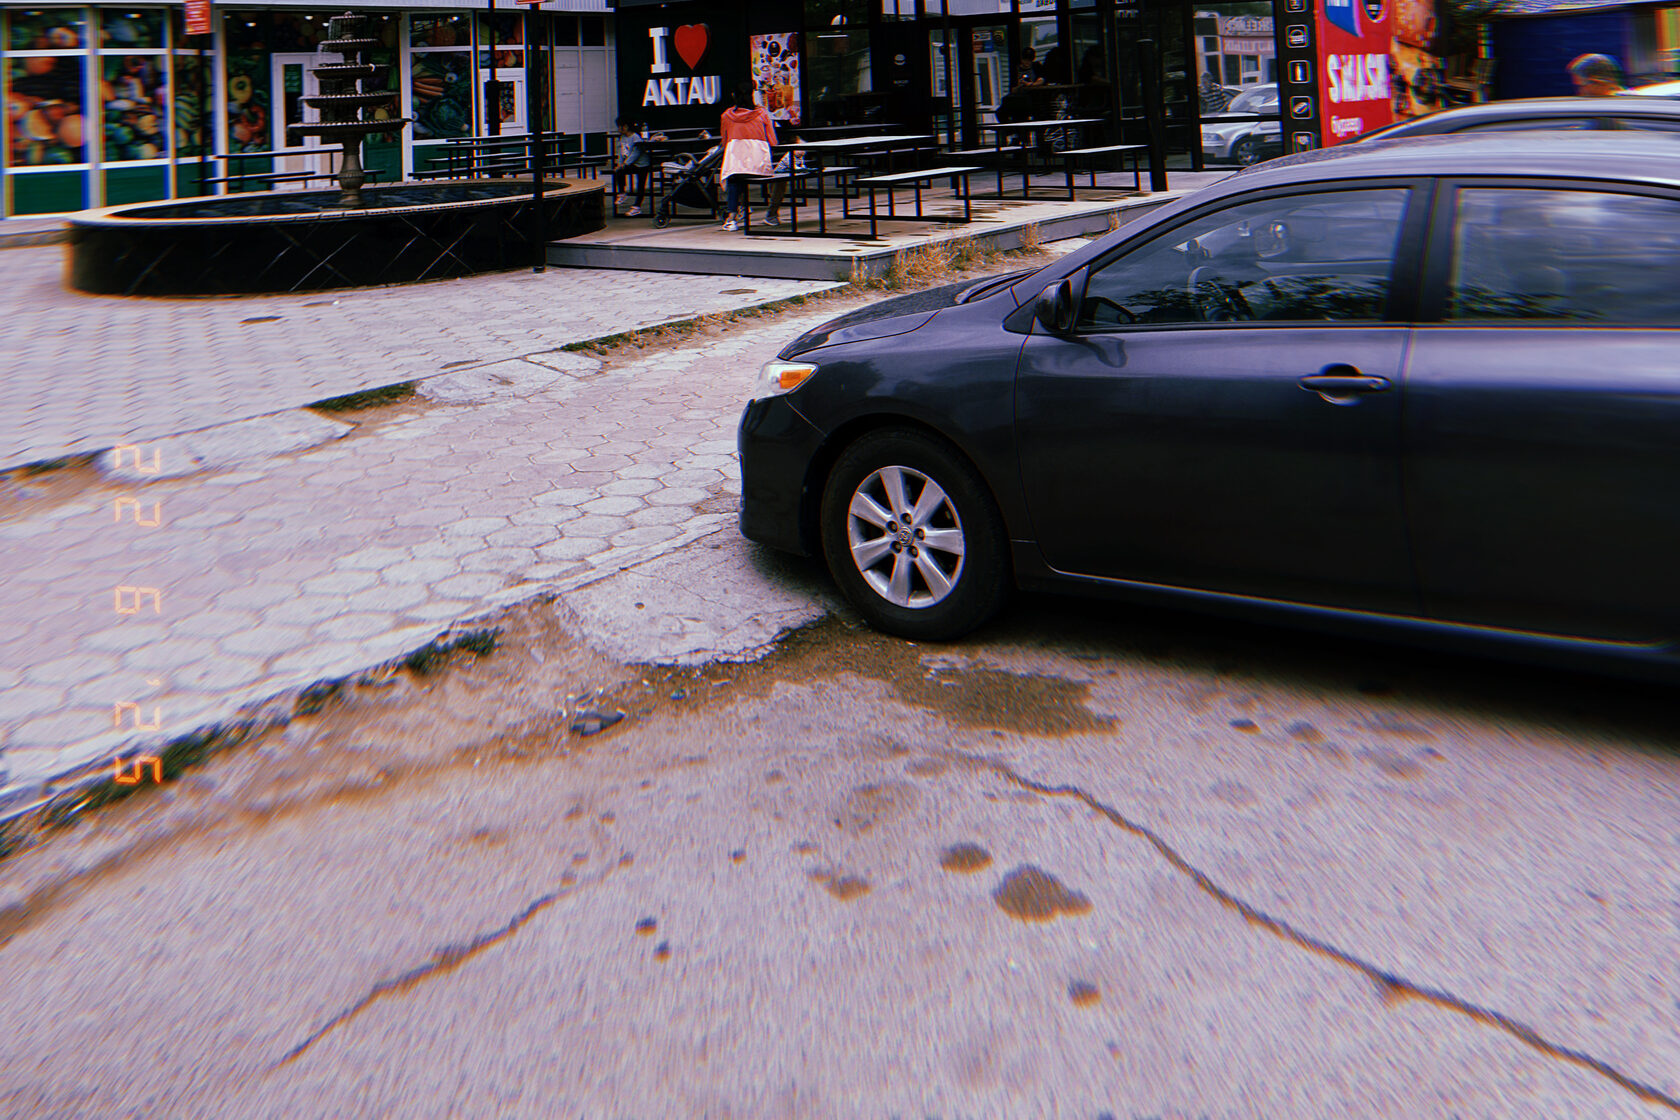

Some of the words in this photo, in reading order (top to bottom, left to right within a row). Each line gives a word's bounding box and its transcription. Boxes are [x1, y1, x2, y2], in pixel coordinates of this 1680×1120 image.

[649, 27, 671, 74] I
[642, 75, 722, 107] AKTAU
[1327, 52, 1392, 104] SMASH
